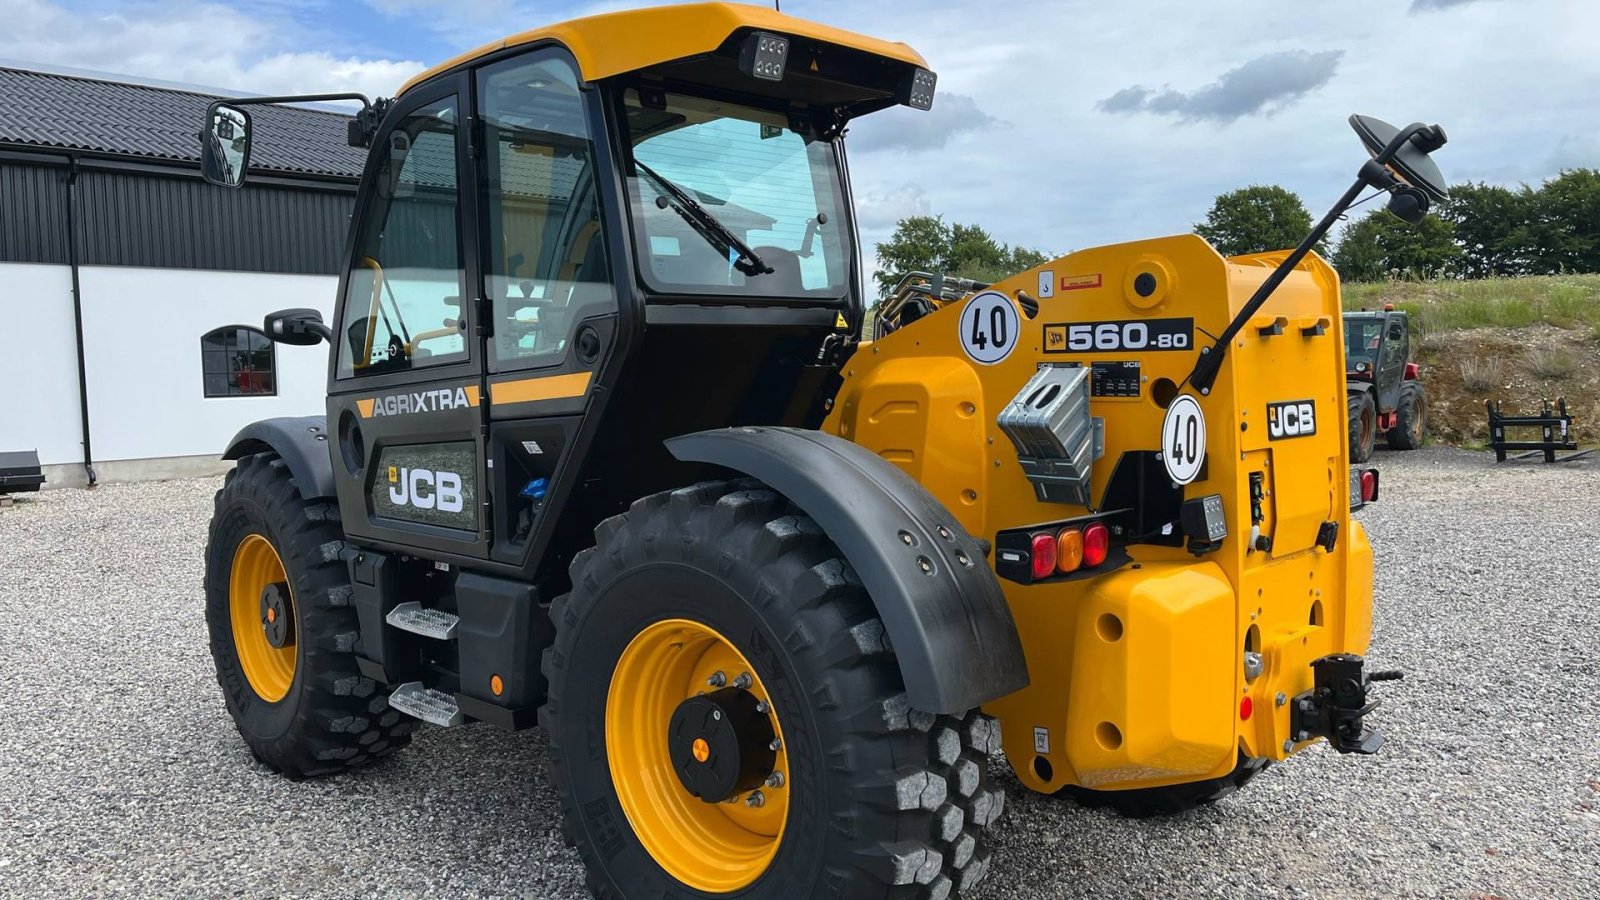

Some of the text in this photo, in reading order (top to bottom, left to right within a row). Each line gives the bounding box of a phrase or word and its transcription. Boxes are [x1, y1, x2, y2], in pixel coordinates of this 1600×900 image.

[972, 305, 1007, 350] 40
[1048, 322, 1188, 350] JCB 560-80
[373, 387, 470, 417] AGRIXTRA
[1270, 403, 1315, 437] JCB
[1172, 414, 1198, 466] 40
[389, 466, 463, 513] JCB
